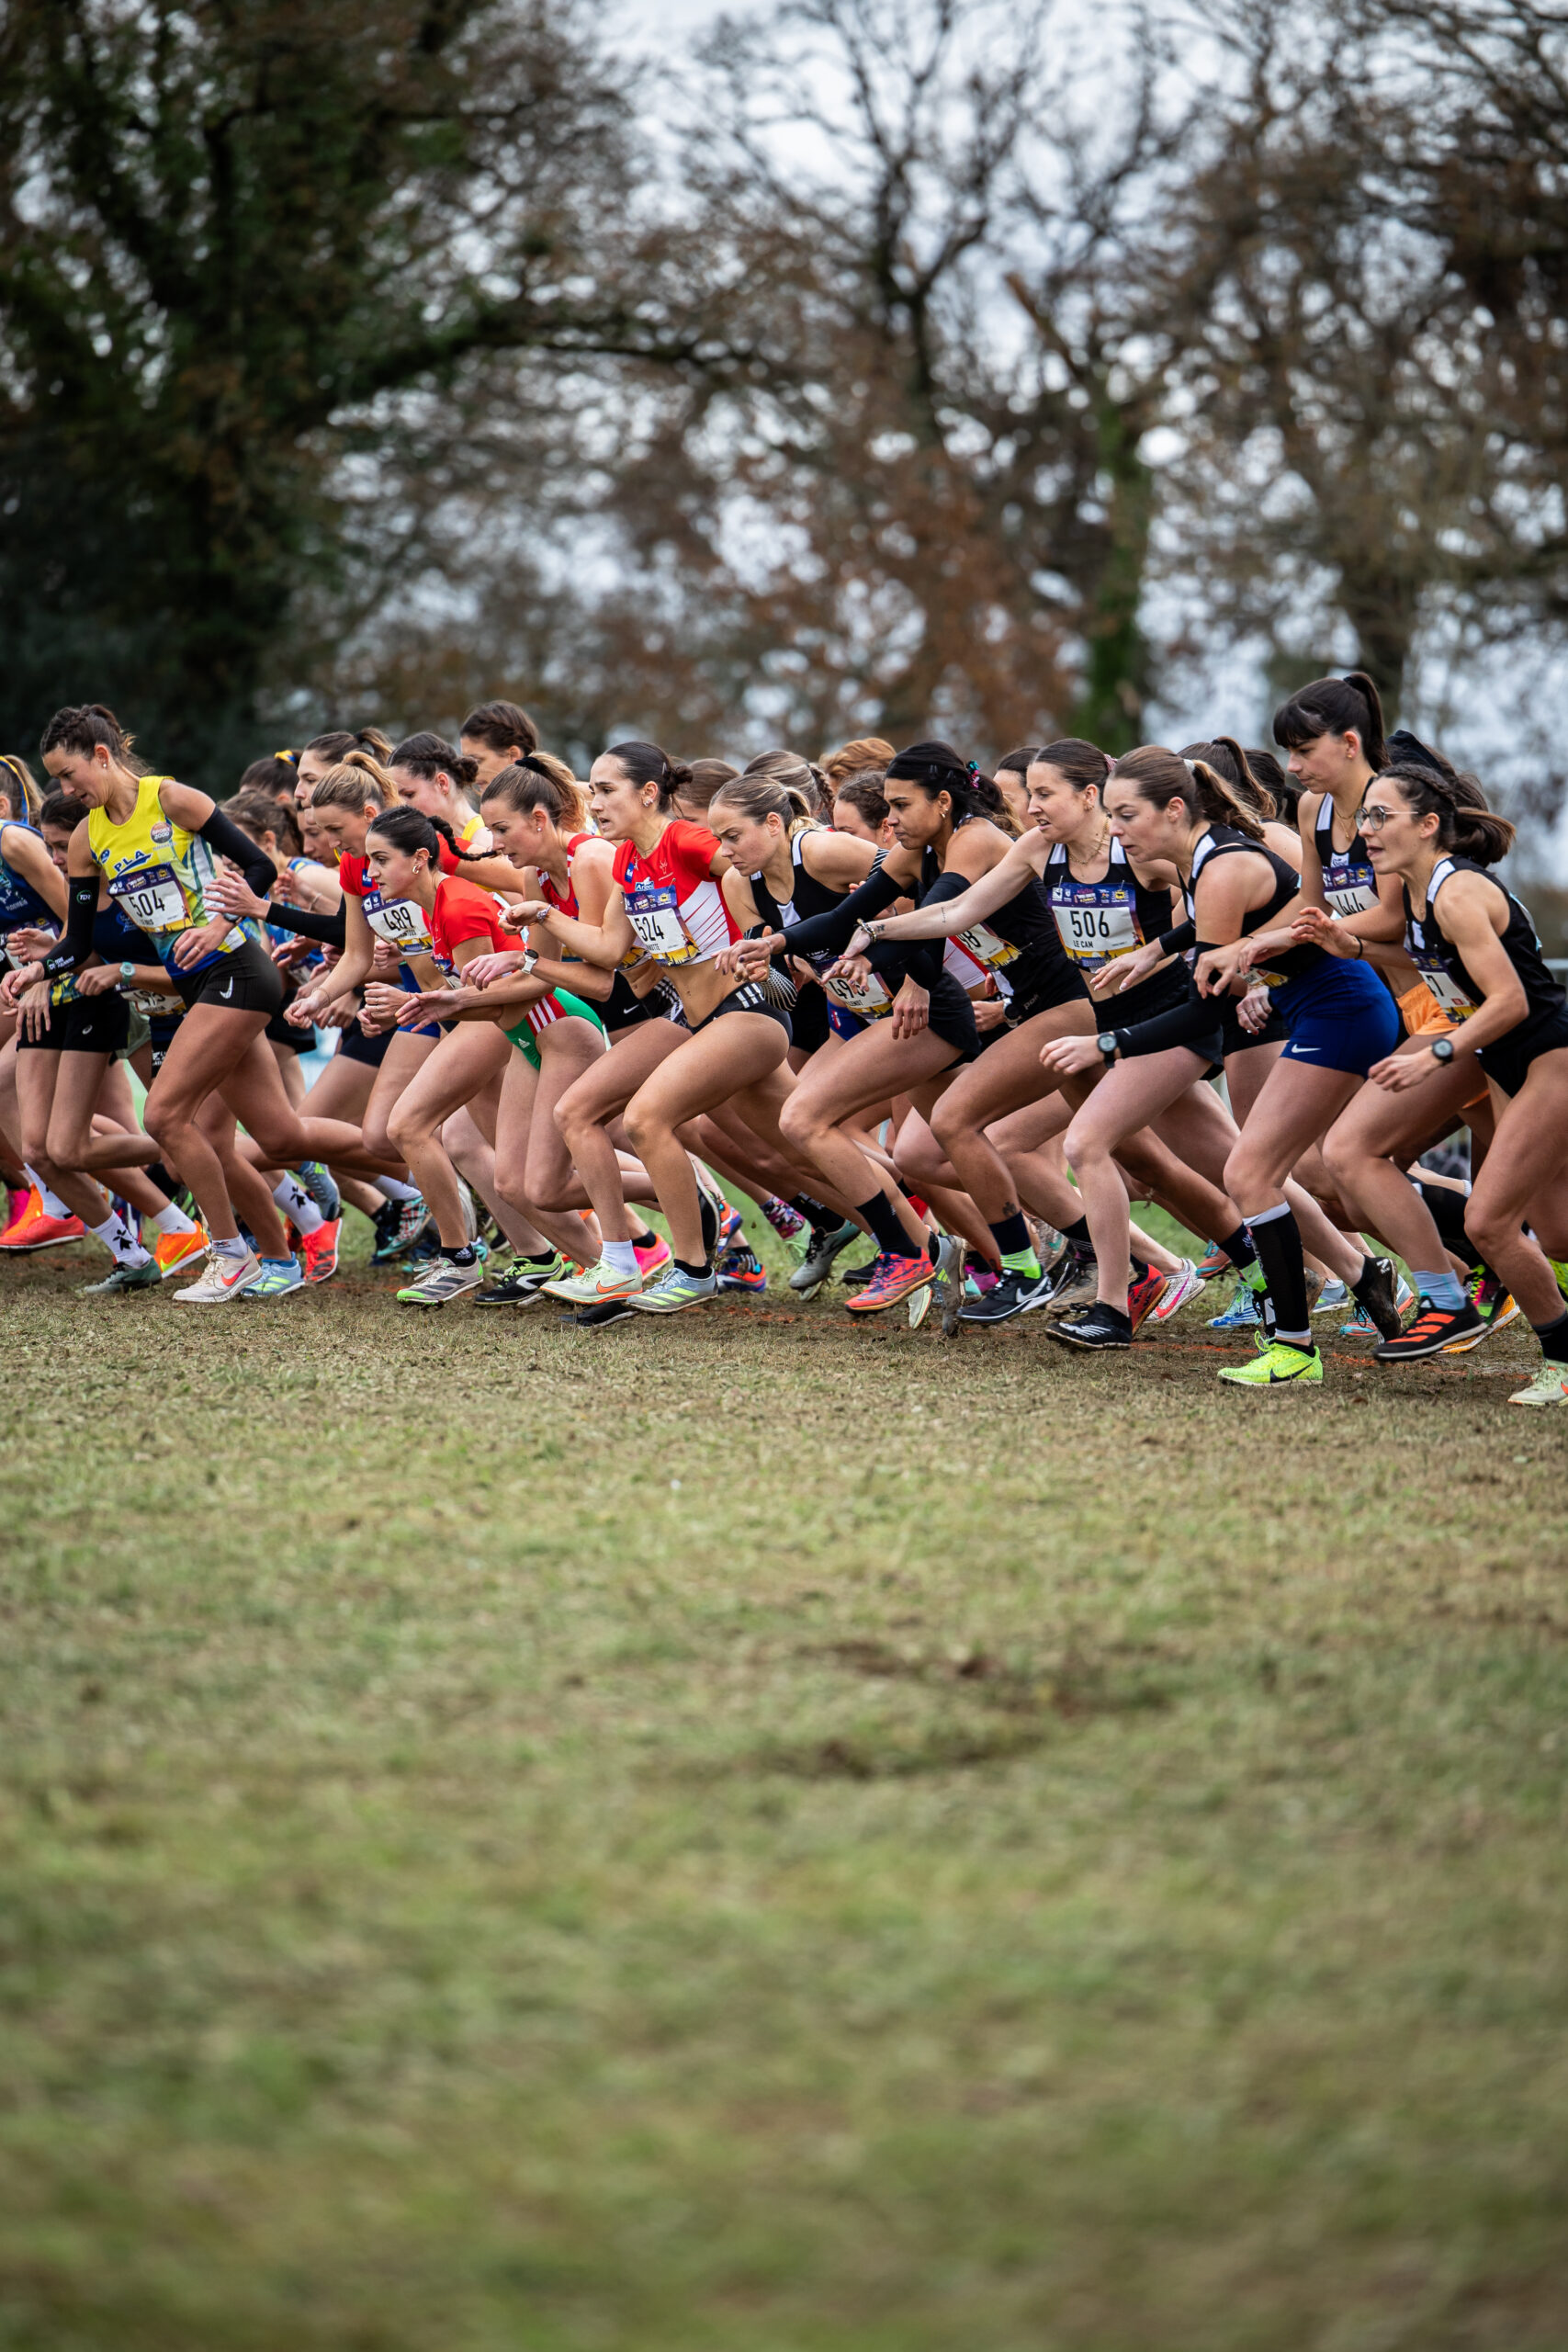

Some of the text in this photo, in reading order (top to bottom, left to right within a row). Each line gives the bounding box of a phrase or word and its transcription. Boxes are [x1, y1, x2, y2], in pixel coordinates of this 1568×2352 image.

[154, 831, 170, 840] 2000
[114, 850, 146, 872] PLA
[129, 889, 165, 918] 504
[383, 906, 414, 931] 489
[634, 915, 664, 942] 524
[1069, 910, 1110, 937] 506
[1081, 940, 1093, 948] CAM
